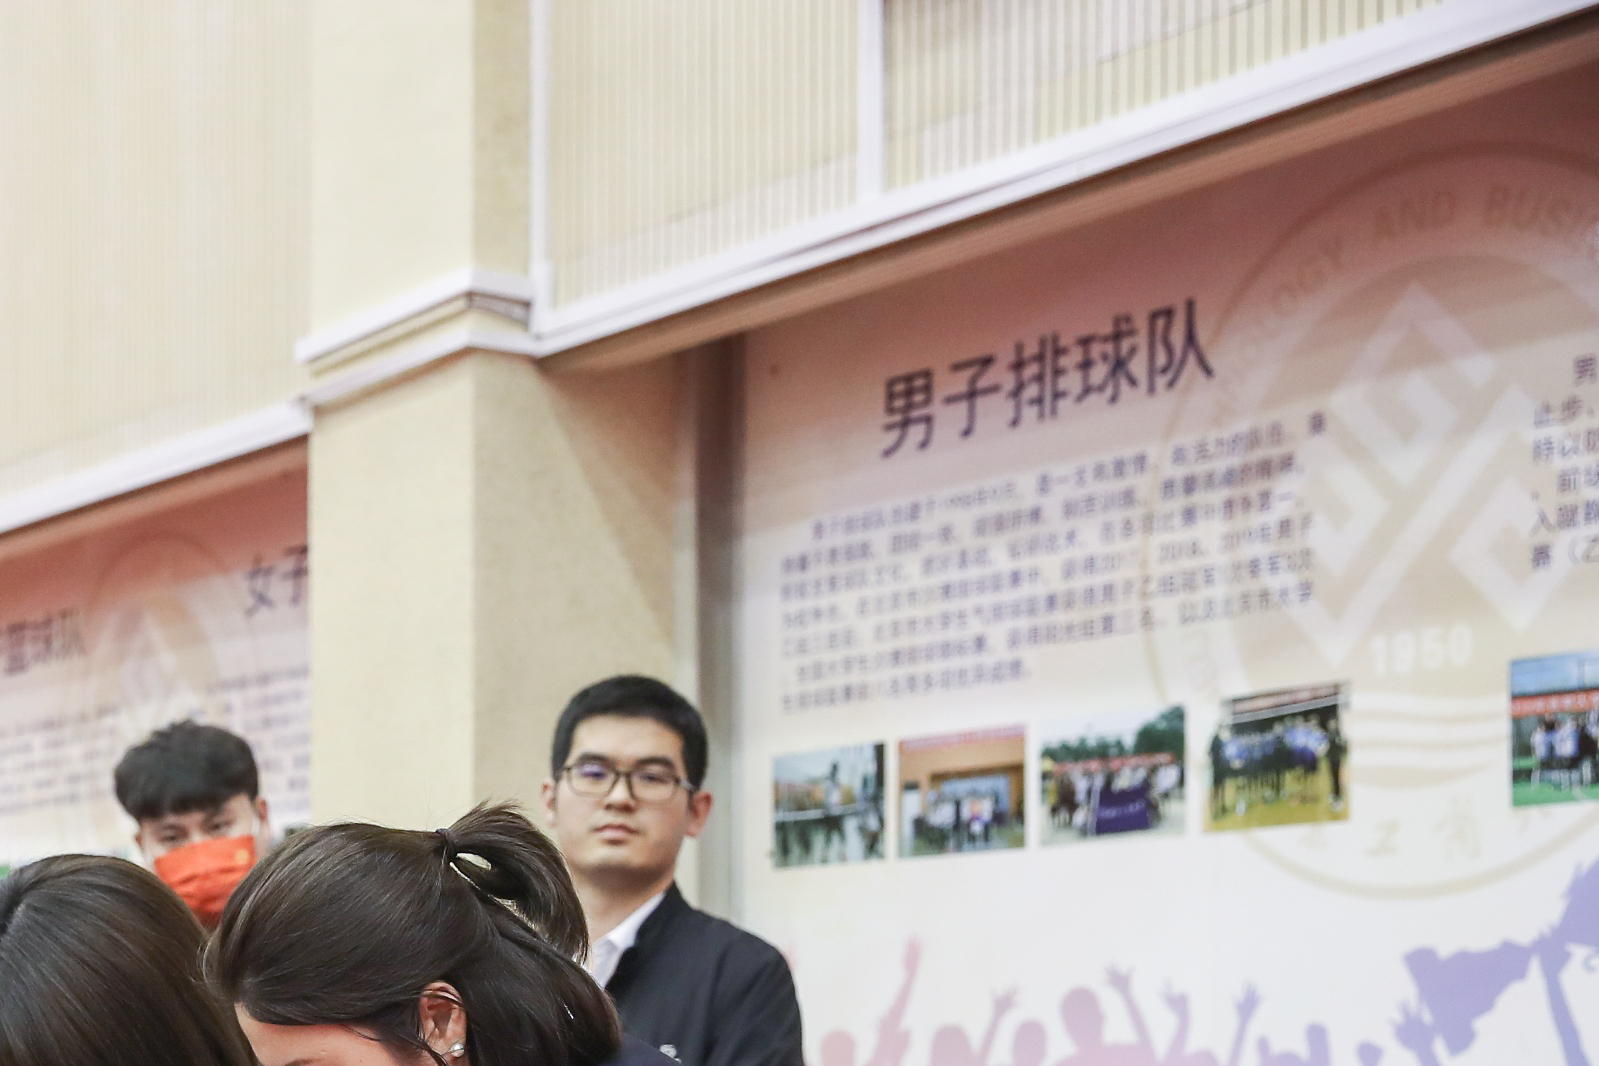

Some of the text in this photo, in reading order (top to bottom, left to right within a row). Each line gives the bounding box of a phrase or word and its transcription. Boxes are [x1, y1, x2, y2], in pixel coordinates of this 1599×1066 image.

[881, 298, 1213, 458] 男子排球队
[1370, 622, 1473, 677] 1950
